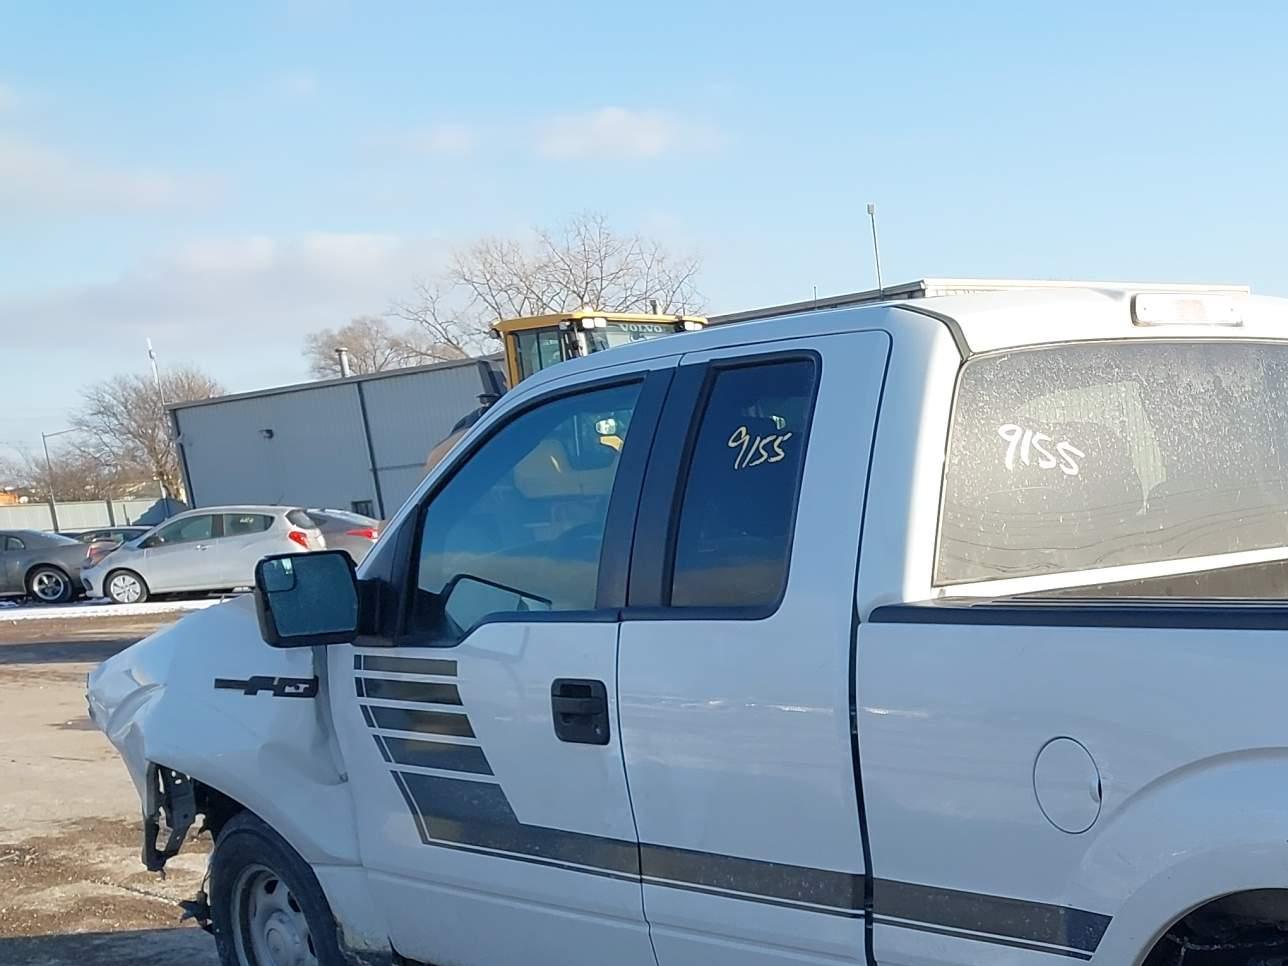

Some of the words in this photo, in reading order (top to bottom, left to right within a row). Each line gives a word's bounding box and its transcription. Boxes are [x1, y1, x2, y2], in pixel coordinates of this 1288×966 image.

[620, 323, 663, 333] VOLVO
[727, 425, 793, 470] 9155
[997, 423, 1086, 476] 9155
